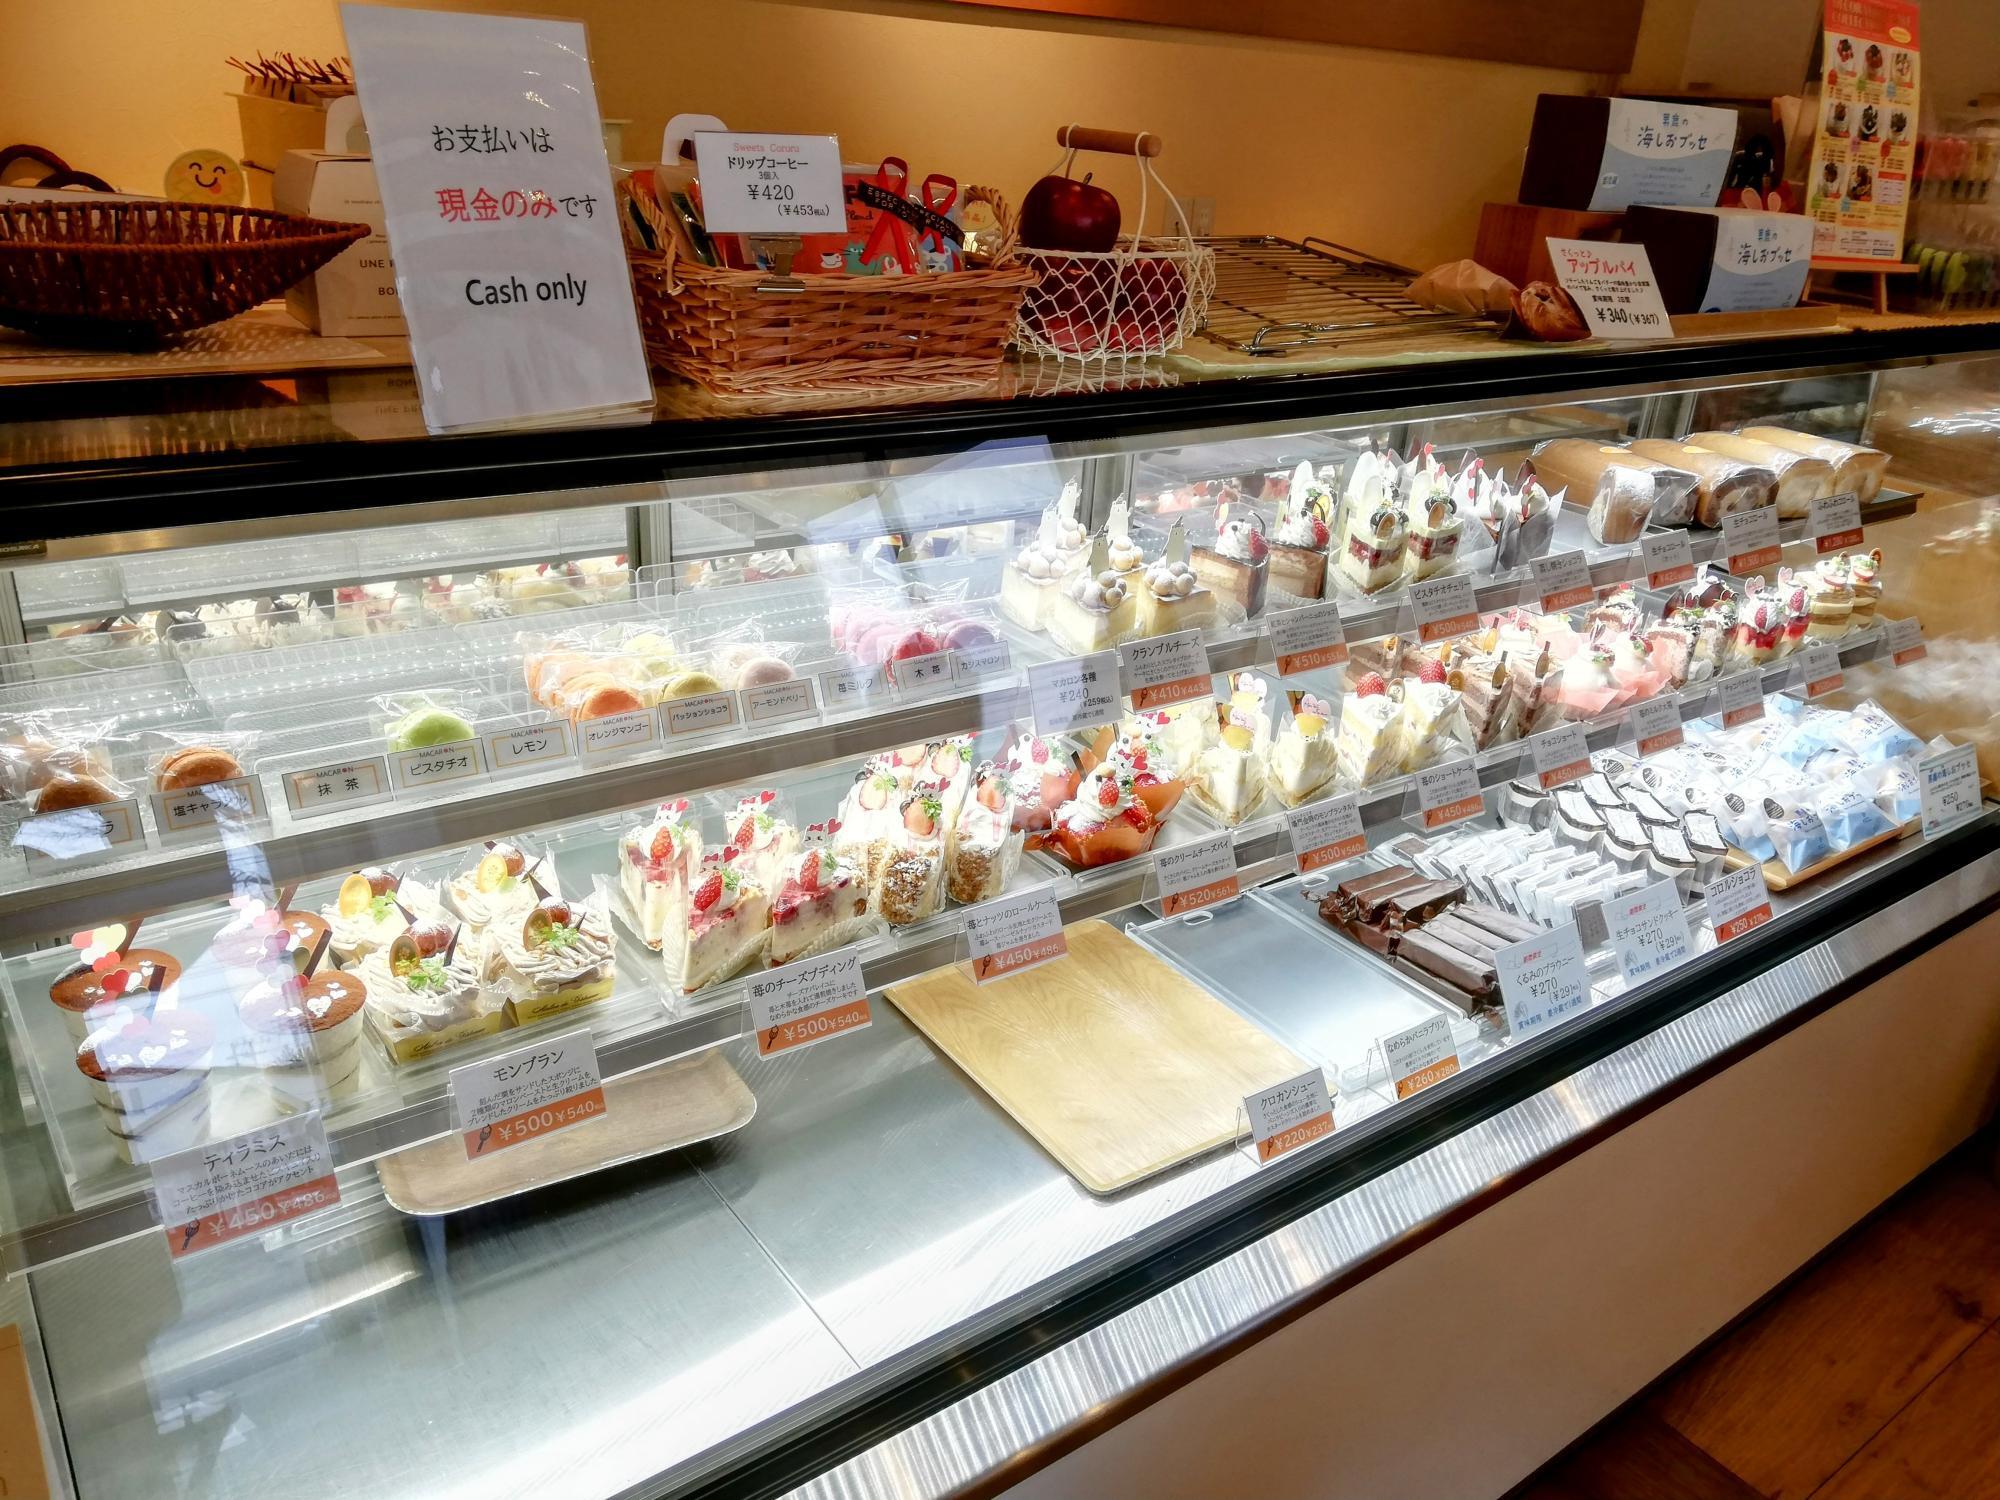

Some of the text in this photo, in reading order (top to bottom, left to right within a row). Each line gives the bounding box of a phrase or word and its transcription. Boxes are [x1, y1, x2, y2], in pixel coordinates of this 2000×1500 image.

[431, 124, 554, 153] お支払いは
[733, 143, 765, 152] Sweets
[727, 156, 808, 169] ドリップコーヒー
[747, 185, 794, 200] ¥420
[435, 187, 597, 222] 現金のみです
[359, 259, 385, 268] UNE
[1567, 258, 1636, 276] アップルパイ
[466, 273, 587, 306] Cash only
[1596, 307, 1660, 326] ¥340 (¥367)
[1132, 636, 1200, 661] クランブルチーズ
[1294, 653, 1320, 668] ¥510
[1051, 671, 1097, 688] マカロン各種
[752, 695, 805, 709] アーモンドベリー
[1058, 687, 1089, 703] ¥240
[1148, 684, 1180, 702] ¥410
[672, 705, 728, 721] パッションショコラ
[588, 723, 649, 741] オレンジマンゴー
[512, 739, 547, 755] レモン
[1421, 764, 1475, 786] 苺のショートケーキ
[1160, 841, 1229, 867] 苺のクリームチーズパイ
[1312, 847, 1340, 864] ¥500
[1710, 867, 1756, 897] コロルショコラ
[1180, 888, 1211, 907] ¥520
[968, 896, 1057, 930] 苺とナッツのロールケーキ
[1616, 909, 1679, 941] 生チョコサンドクッキー
[1637, 927, 1663, 946] ¥270
[995, 944, 1060, 969] ¥450 ¥486
[752, 956, 857, 998] 苺のチーズプディング
[1516, 957, 1575, 986] くるみのブラウニー
[1530, 976, 1558, 998] ¥270
[784, 1011, 860, 1041] ¥500 ¥540
[1387, 1019, 1446, 1053] なめらかバニラプリン
[494, 1051, 564, 1082] モンブラン
[1408, 1070, 1434, 1091] ¥260
[467, 1077, 599, 1126] ブレンドしたクリームをたっぷり絞りました
[1260, 1081, 1316, 1110] クロカンシュー
[498, 1101, 594, 1141] ¥500 ¥540
[1275, 1121, 1328, 1150] ¥220 ¥237
[203, 1134, 286, 1172] ティラミス
[208, 1189, 325, 1237] ¥450 ¥486
